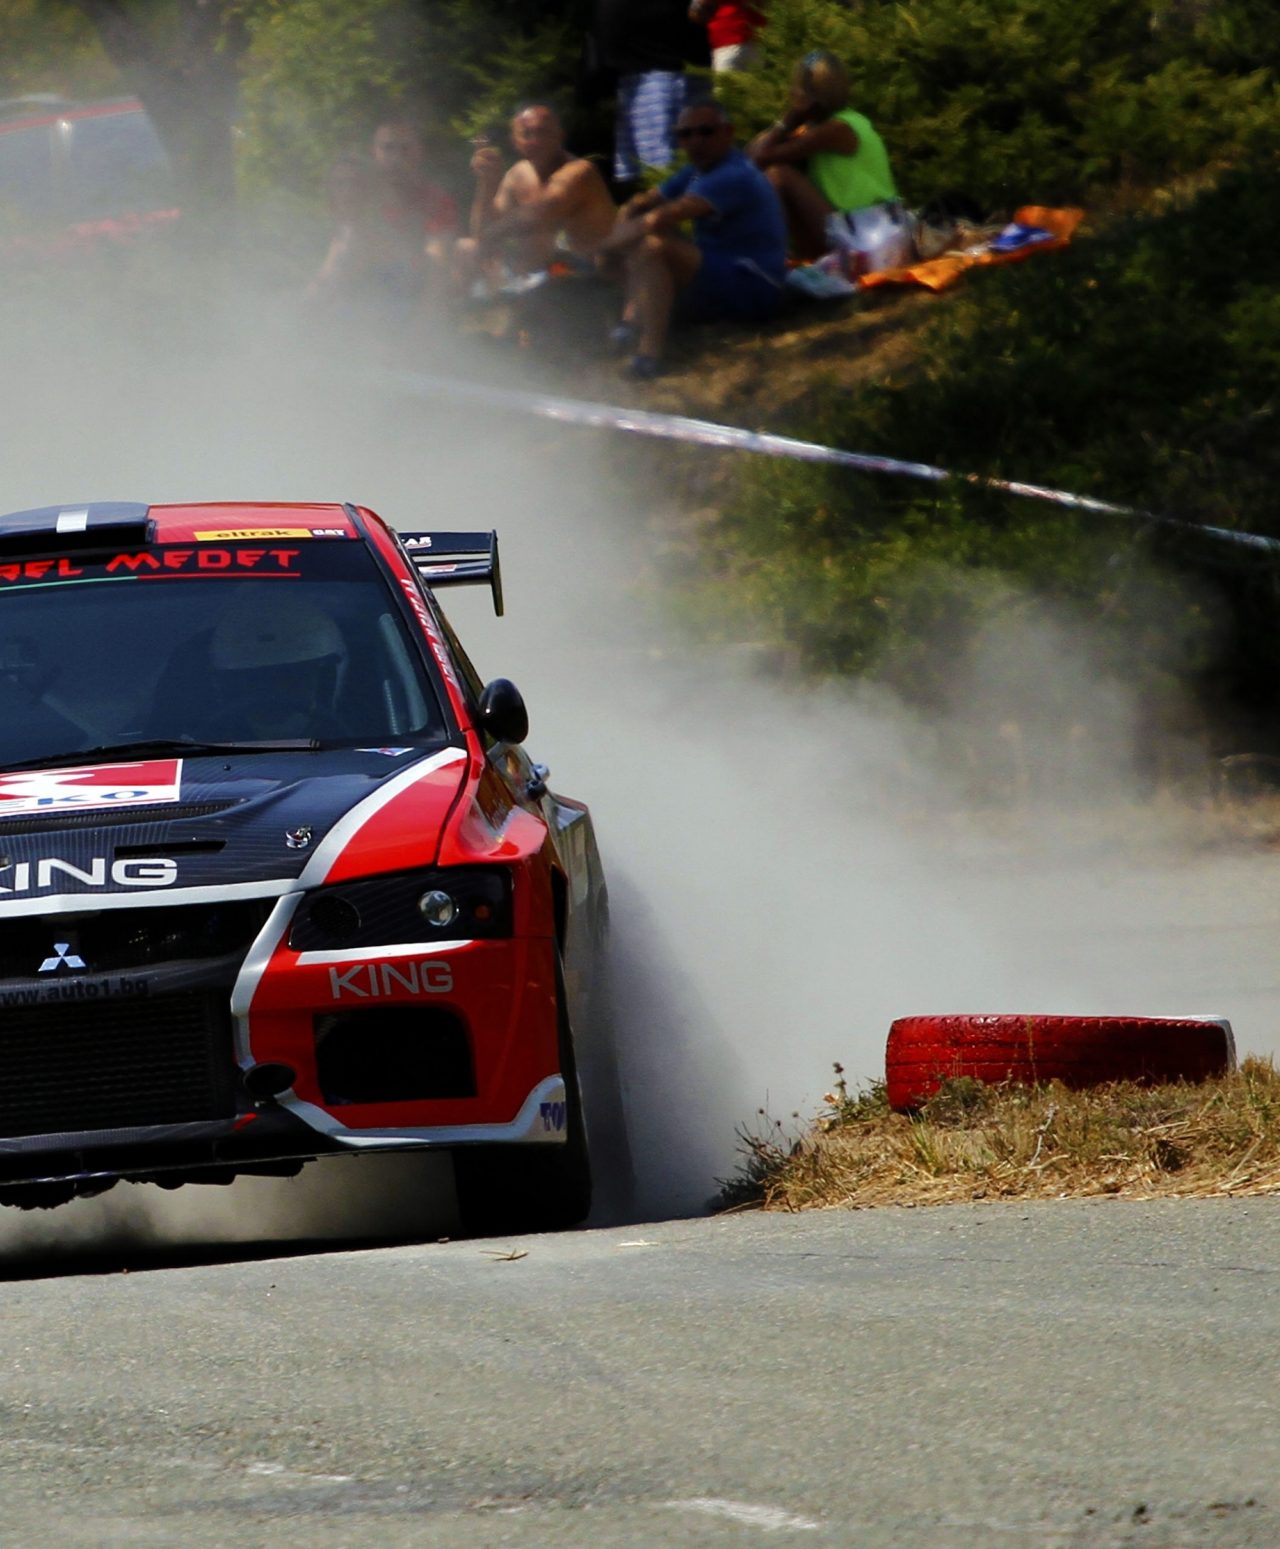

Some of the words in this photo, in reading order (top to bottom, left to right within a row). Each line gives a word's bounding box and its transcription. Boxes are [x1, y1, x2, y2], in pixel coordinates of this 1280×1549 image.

[216, 529, 291, 539] eltrak
[106, 549, 300, 573] MEDET
[328, 960, 454, 999] KING
